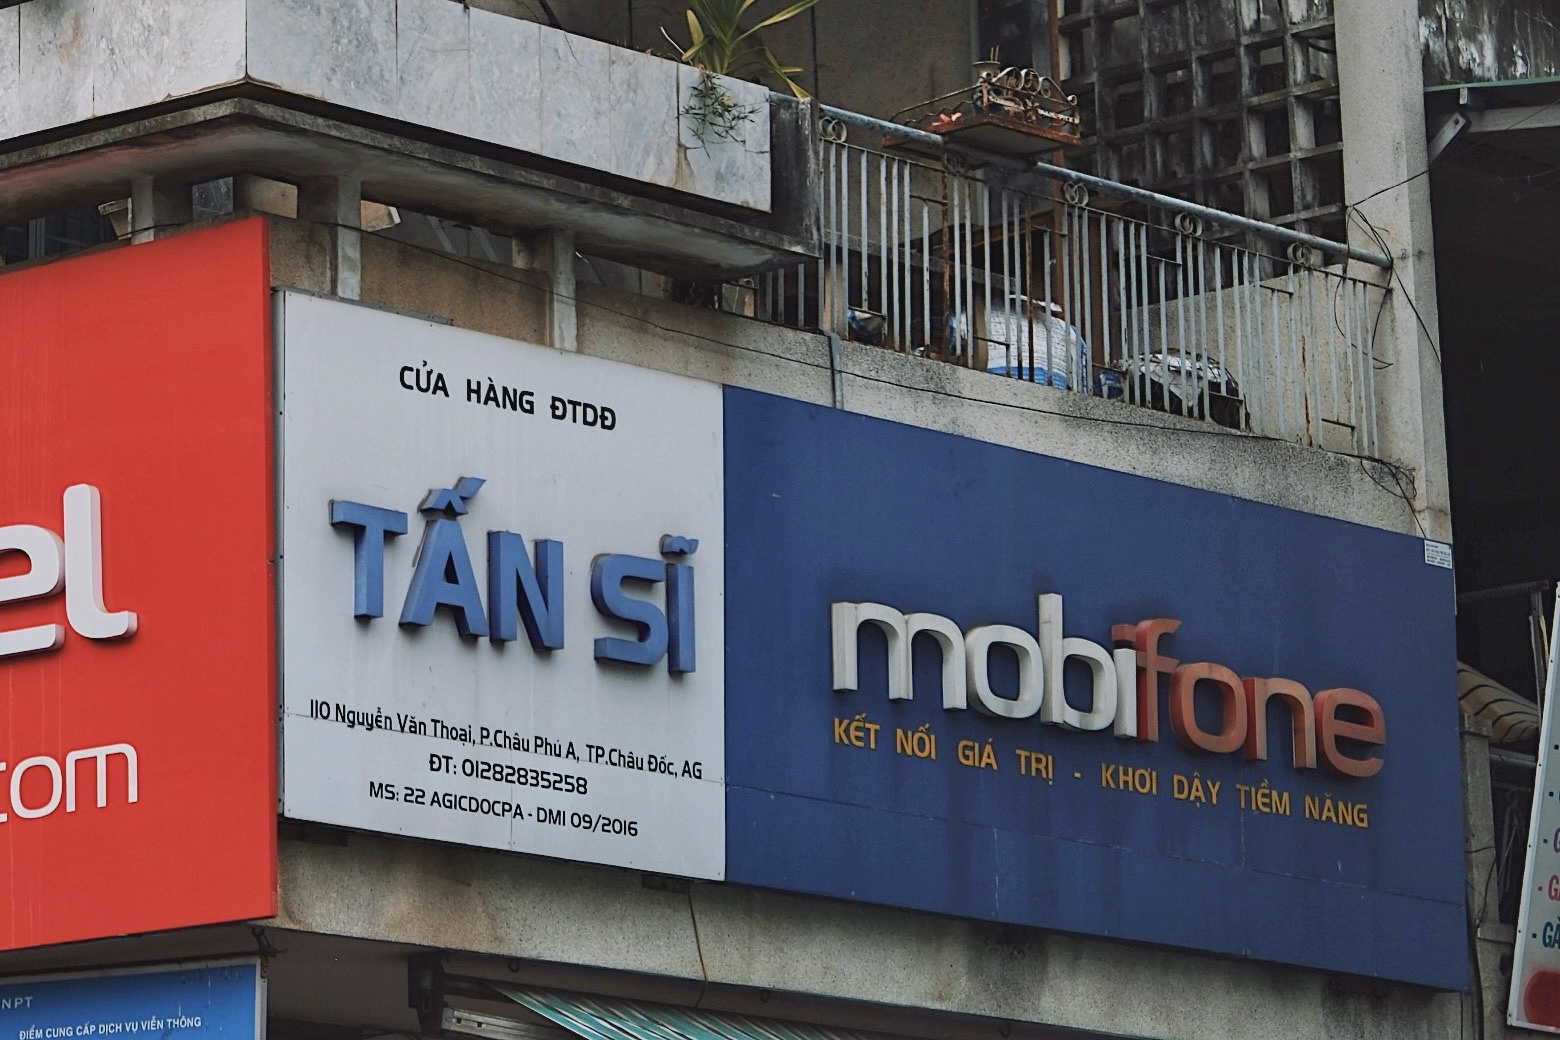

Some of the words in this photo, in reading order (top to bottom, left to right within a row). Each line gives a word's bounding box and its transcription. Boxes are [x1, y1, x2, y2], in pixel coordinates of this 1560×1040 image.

[399, 359, 450, 398] CỬA
[466, 376, 535, 415] HÀNG
[549, 395, 617, 431] ĐTDĐ
[330, 476, 566, 652] TẤN
[590, 533, 700, 674] SĨ
[832, 593, 1386, 778] mobifone
[395, 712, 427, 737] Văn
[430, 718, 476, 747] Thoại,
[534, 735, 562, 758] Phú
[565, 741, 580, 764] A,
[647, 753, 678, 779] Đốc,
[681, 759, 703, 780] AG
[428, 753, 457, 775] ĐT:
[833, 714, 880, 749] KẾT
[895, 725, 937, 760] NỐI
[957, 739, 998, 769] GIÁ
[1015, 749, 1054, 785] TRỊ
[1172, 772, 1221, 808] DẬY
[1304, 795, 1369, 829] NĂNG
[369, 780, 399, 802] MS:
[403, 786, 426, 806] 22
[570, 812, 639, 837] 09/2016
[45, 1026, 73, 1039] CUNG
[76, 1021, 96, 1036] CẤP
[98, 1023, 122, 1036] DỊCH
[125, 1021, 139, 1034] VỤ
[167, 1016, 202, 1029] THÔNG
